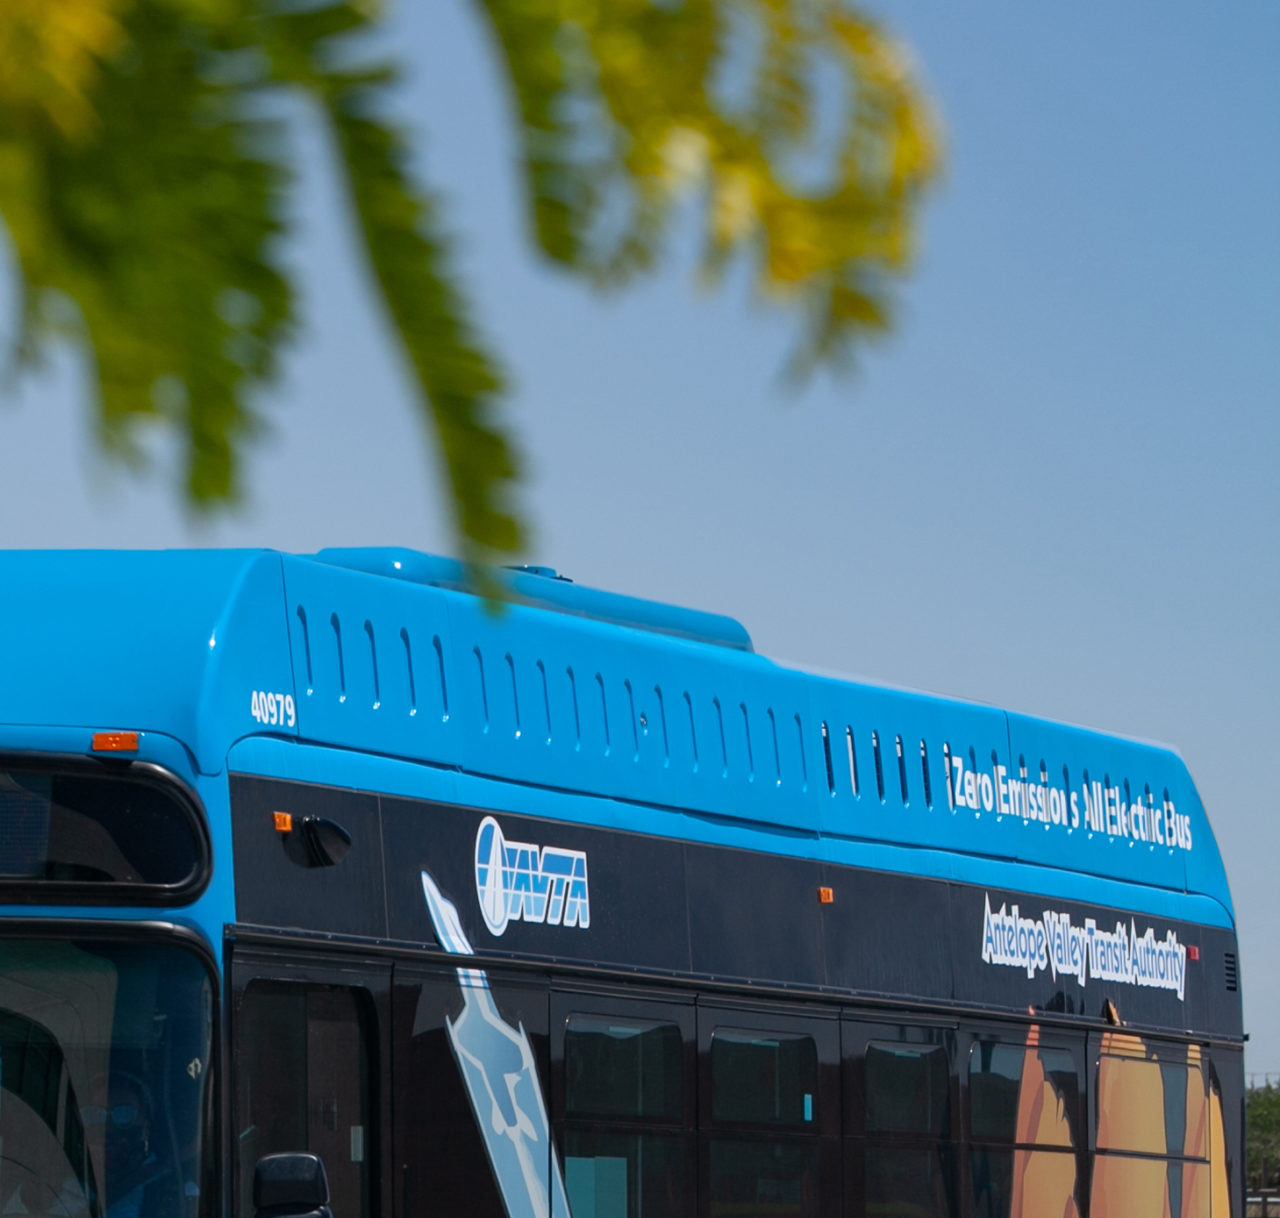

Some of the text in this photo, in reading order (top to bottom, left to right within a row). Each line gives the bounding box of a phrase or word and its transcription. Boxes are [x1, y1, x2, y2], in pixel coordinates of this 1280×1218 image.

[251, 690, 296, 727] 40979
[952, 755, 994, 812] Zero
[1083, 780, 1105, 833] All
[1163, 800, 1192, 851] Bus
[983, 898, 1186, 997] Antelope Valley Transit Authority
